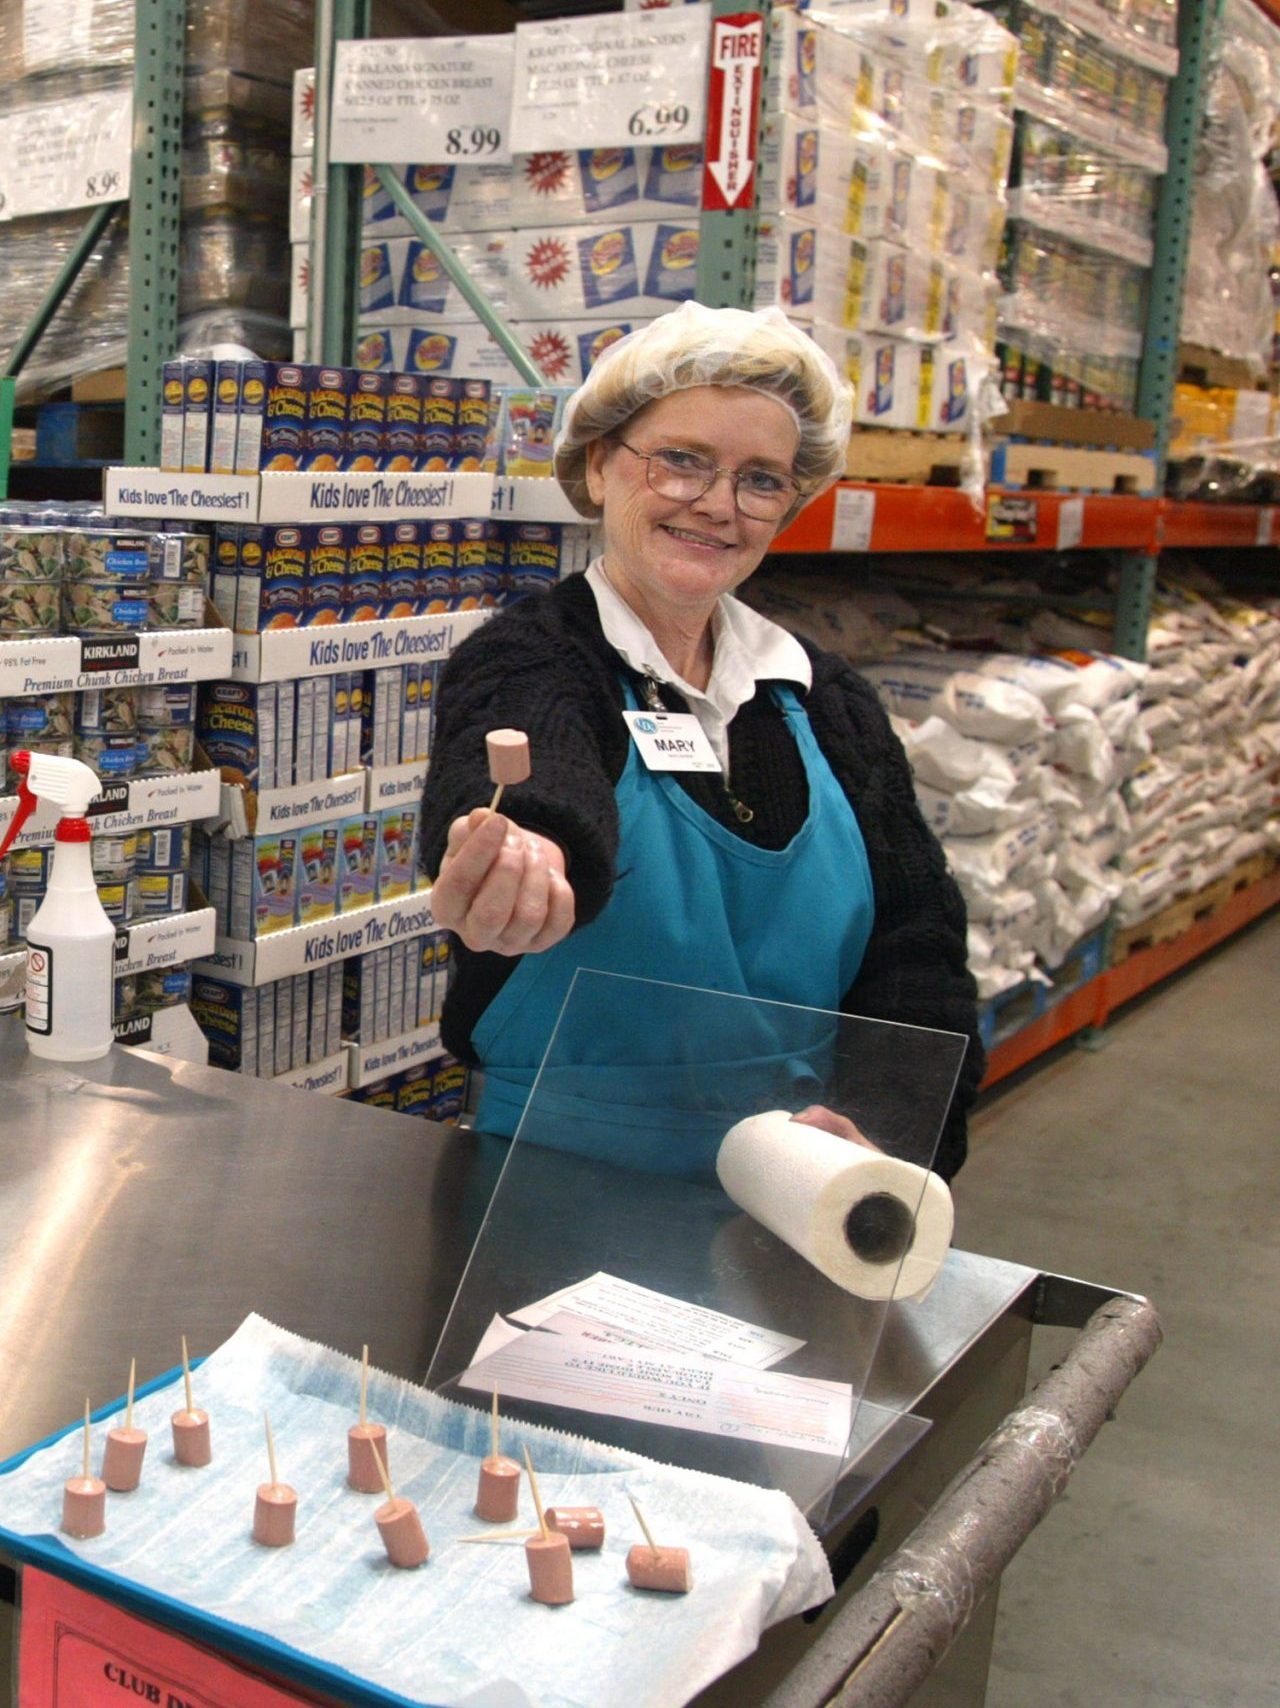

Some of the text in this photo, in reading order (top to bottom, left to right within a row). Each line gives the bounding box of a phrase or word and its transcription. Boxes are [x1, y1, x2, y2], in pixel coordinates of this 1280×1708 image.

[721, 33, 757, 59] FIRE
[452, 77, 493, 89] BREAST
[628, 105, 689, 137] 6.99
[727, 63, 743, 191] EXTINGUISHER
[446, 127, 501, 155] 8.99
[118, 487, 142, 505] Kids
[144, 489, 168, 506] love
[168, 488, 189, 506] The
[310, 481, 339, 509] Kids
[342, 481, 370, 509] love
[372, 479, 394, 508] The
[32, 656, 46, 666] Free
[84, 643, 138, 660] KIRKLAND
[310, 641, 339, 667] Kids
[341, 638, 368, 662] love
[370, 632, 393, 660] The
[23, 667, 188, 692] Premium Chunk Chicken Breast
[210, 716, 255, 734] Cheese
[654, 739, 696, 752] MARY
[379, 779, 417, 798] Kids love
[270, 803, 290, 821] Kids
[292, 801, 309, 817] love
[310, 796, 324, 813] The
[12, 826, 56, 845] Premiu
[103, 812, 144, 830] Chicken
[147, 807, 178, 823] Breast
[304, 907, 433, 964] Kids love The Cheesies
[147, 949, 178, 964] Breast
[103, 1661, 161, 1705] CLUB
